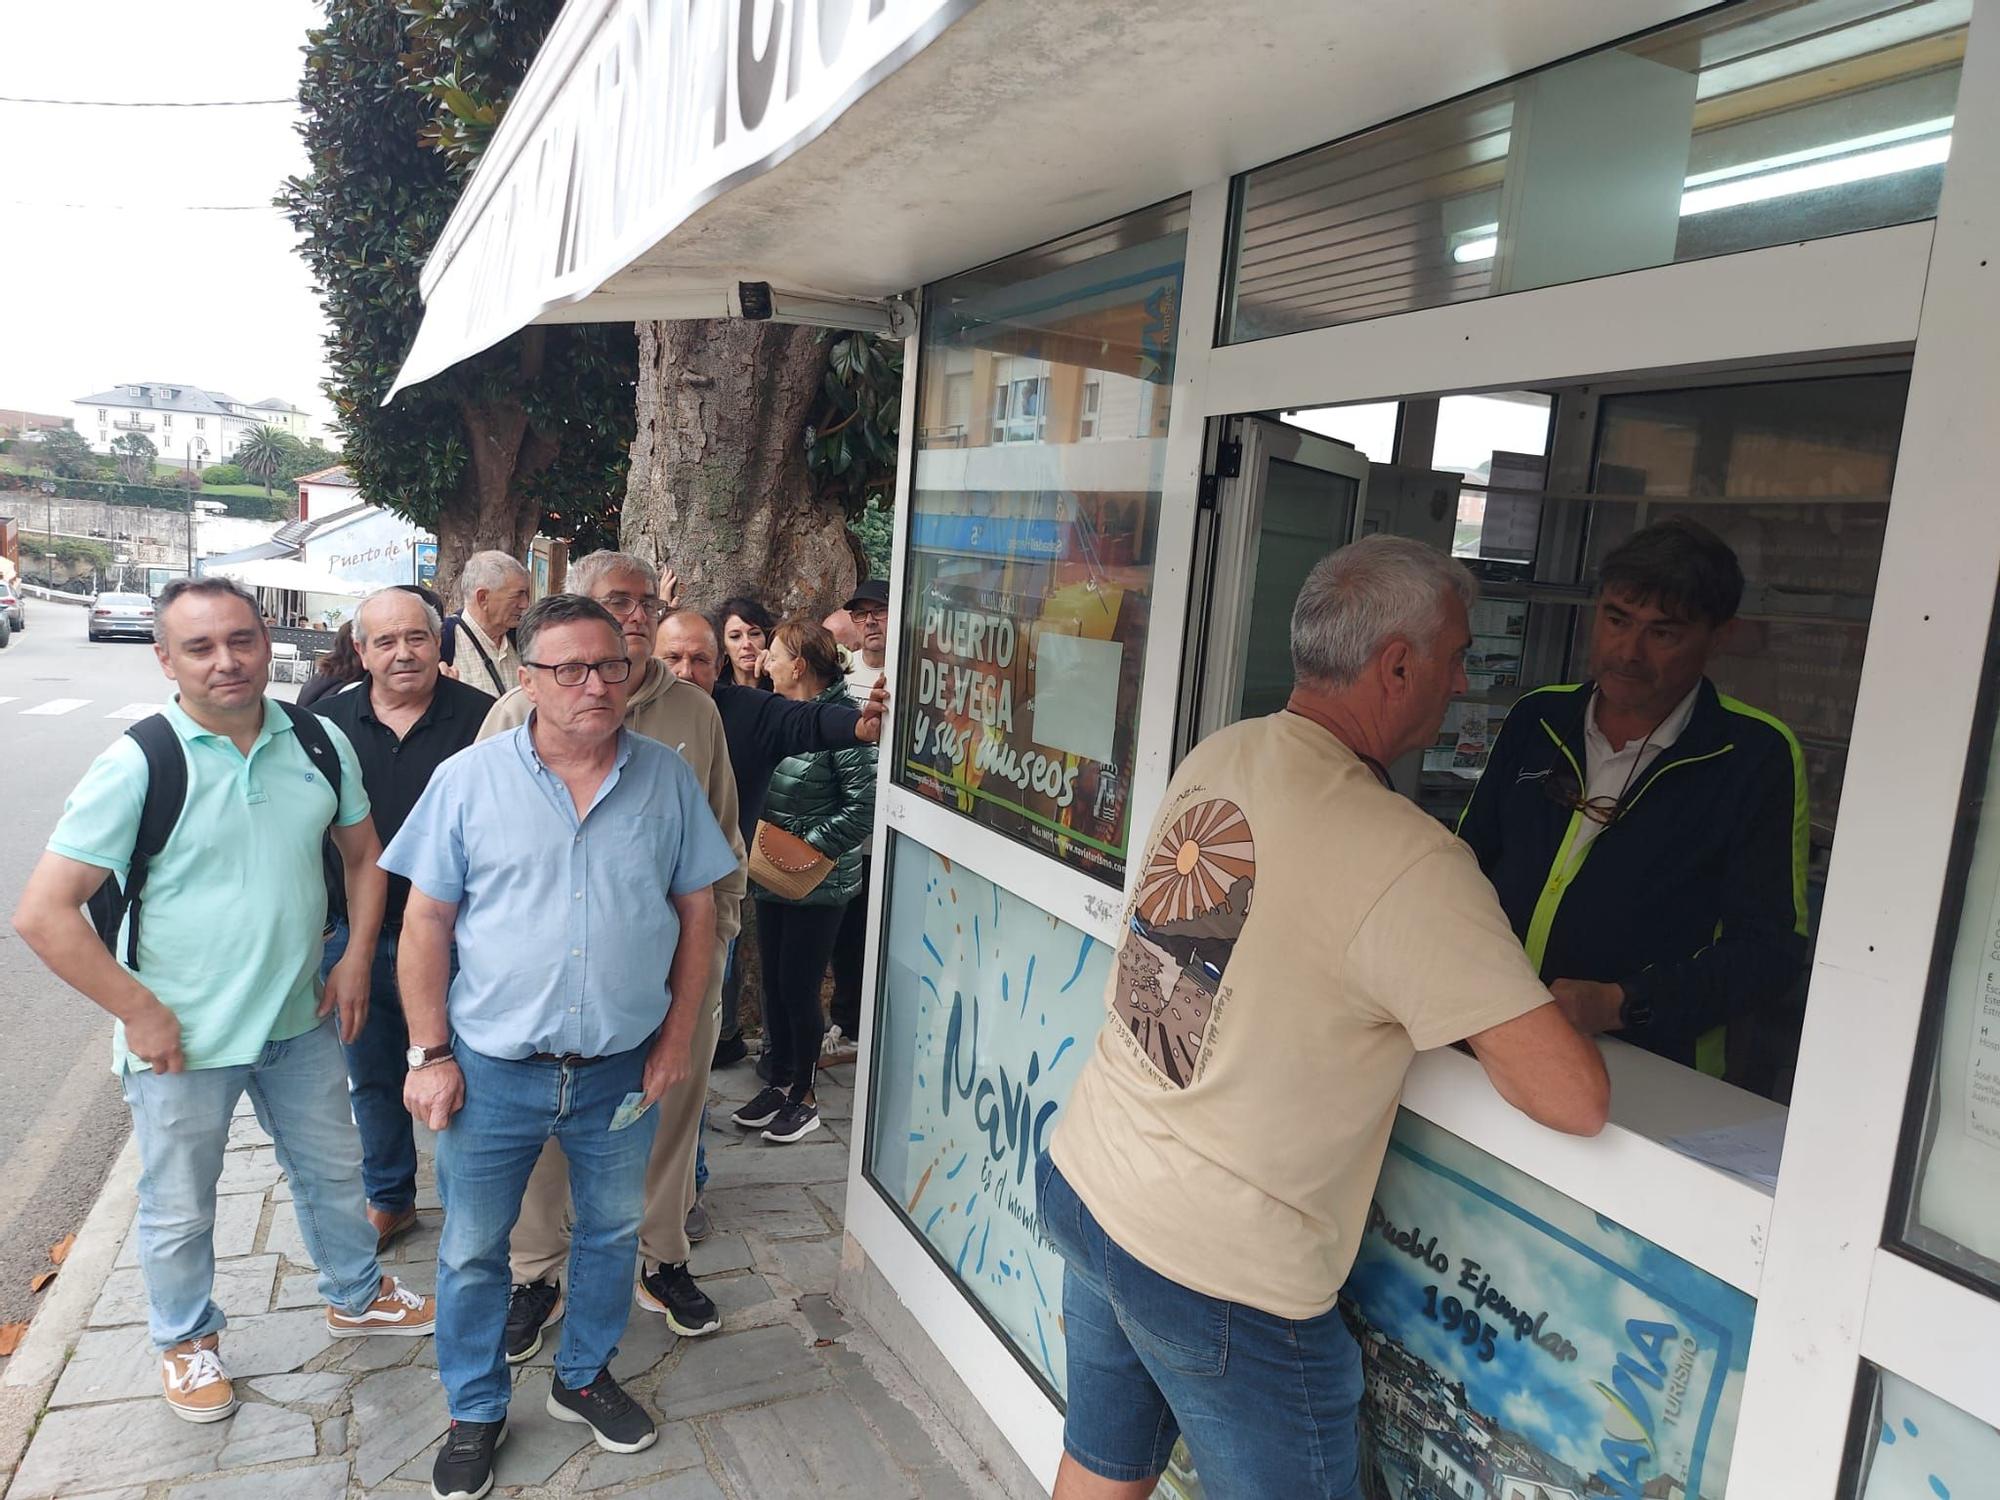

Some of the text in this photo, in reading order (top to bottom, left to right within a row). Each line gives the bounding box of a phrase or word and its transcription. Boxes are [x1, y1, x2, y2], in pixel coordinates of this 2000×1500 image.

[552, 0, 886, 278] INFORMAC
[328, 547, 381, 575] Puerto
[384, 540, 401, 561] de
[922, 607, 1016, 669] PUERTO
[918, 658, 1014, 734] DE VEGA
[913, 709, 930, 756] y
[931, 721, 972, 766] sus
[974, 735, 1079, 808] museos
[981, 1155, 993, 1193] Es
[1366, 1198, 1578, 1363] Pueblo Ejemplar
[1421, 1284, 1499, 1363] 1995
[1662, 1337, 1698, 1427] TURISMO
